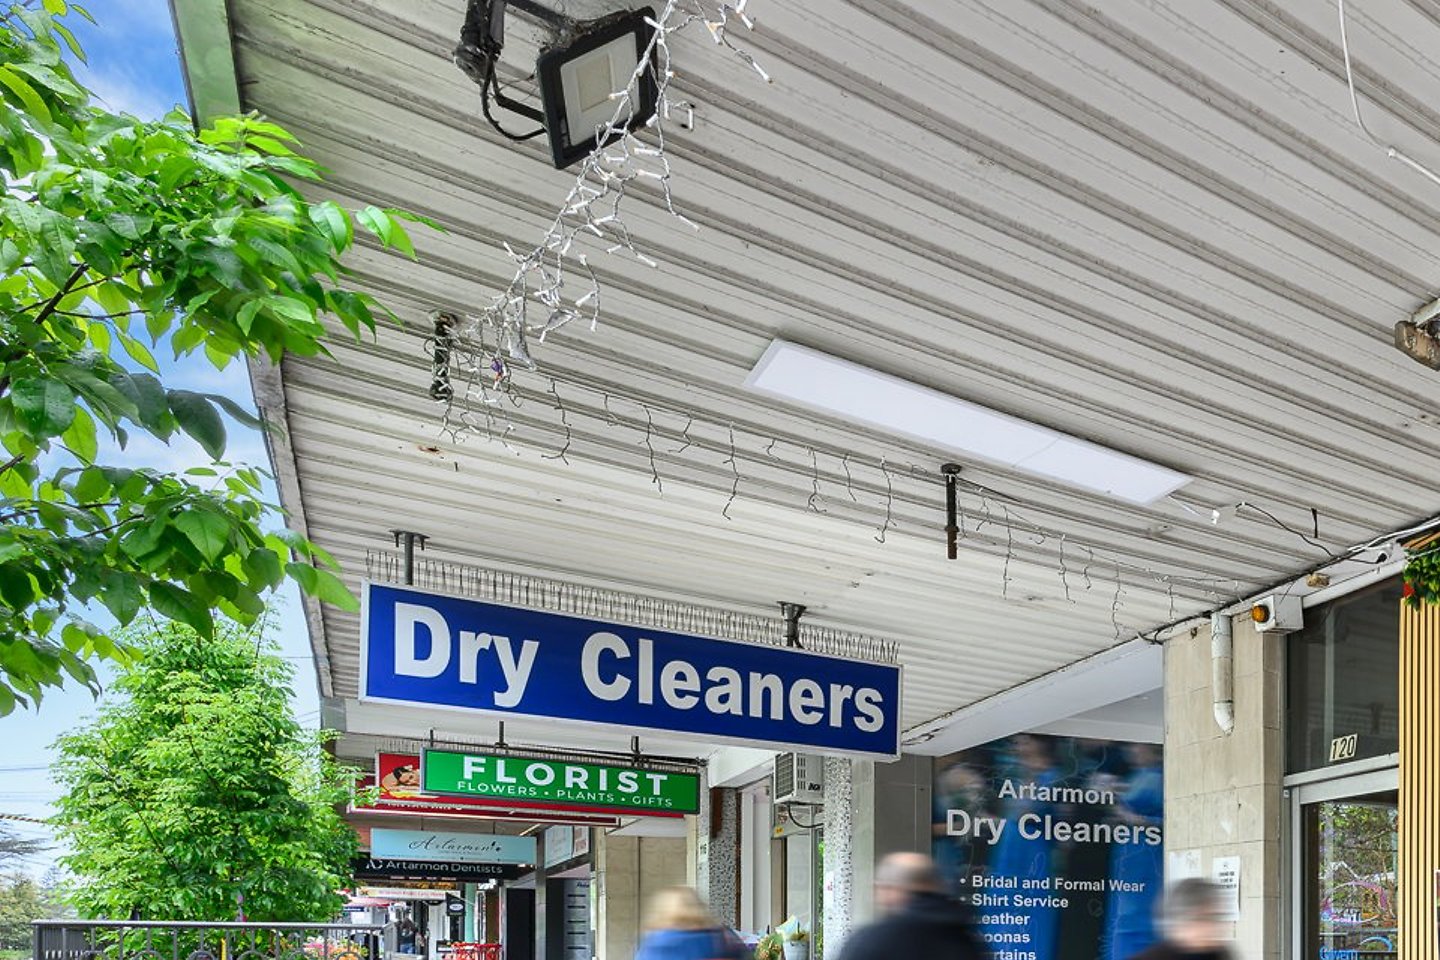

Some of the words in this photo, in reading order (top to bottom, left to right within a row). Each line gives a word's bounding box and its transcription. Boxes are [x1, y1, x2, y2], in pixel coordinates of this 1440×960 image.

[393, 602, 540, 708] Dry
[580, 631, 885, 734] Cleaners
[1332, 736, 1355, 760] 120
[463, 756, 668, 796] FLORIST
[457, 781, 537, 797] FLOWERS
[557, 789, 615, 803] PLANTS
[632, 795, 674, 808] GIFTS
[998, 779, 1115, 805] Artarmon
[946, 809, 1007, 845] Dry
[1018, 813, 1163, 845] Cleaners
[386, 859, 449, 872] Artarmon
[451, 863, 504, 874] Dentists
[972, 875, 1018, 889] Bridal
[1022, 877, 1050, 890] and
[1054, 878, 1105, 892] Formal
[1109, 879, 1146, 893] Wear
[971, 893, 1010, 907] Shirt
[1013, 895, 1069, 908] Service
[981, 931, 1031, 943] oonas
